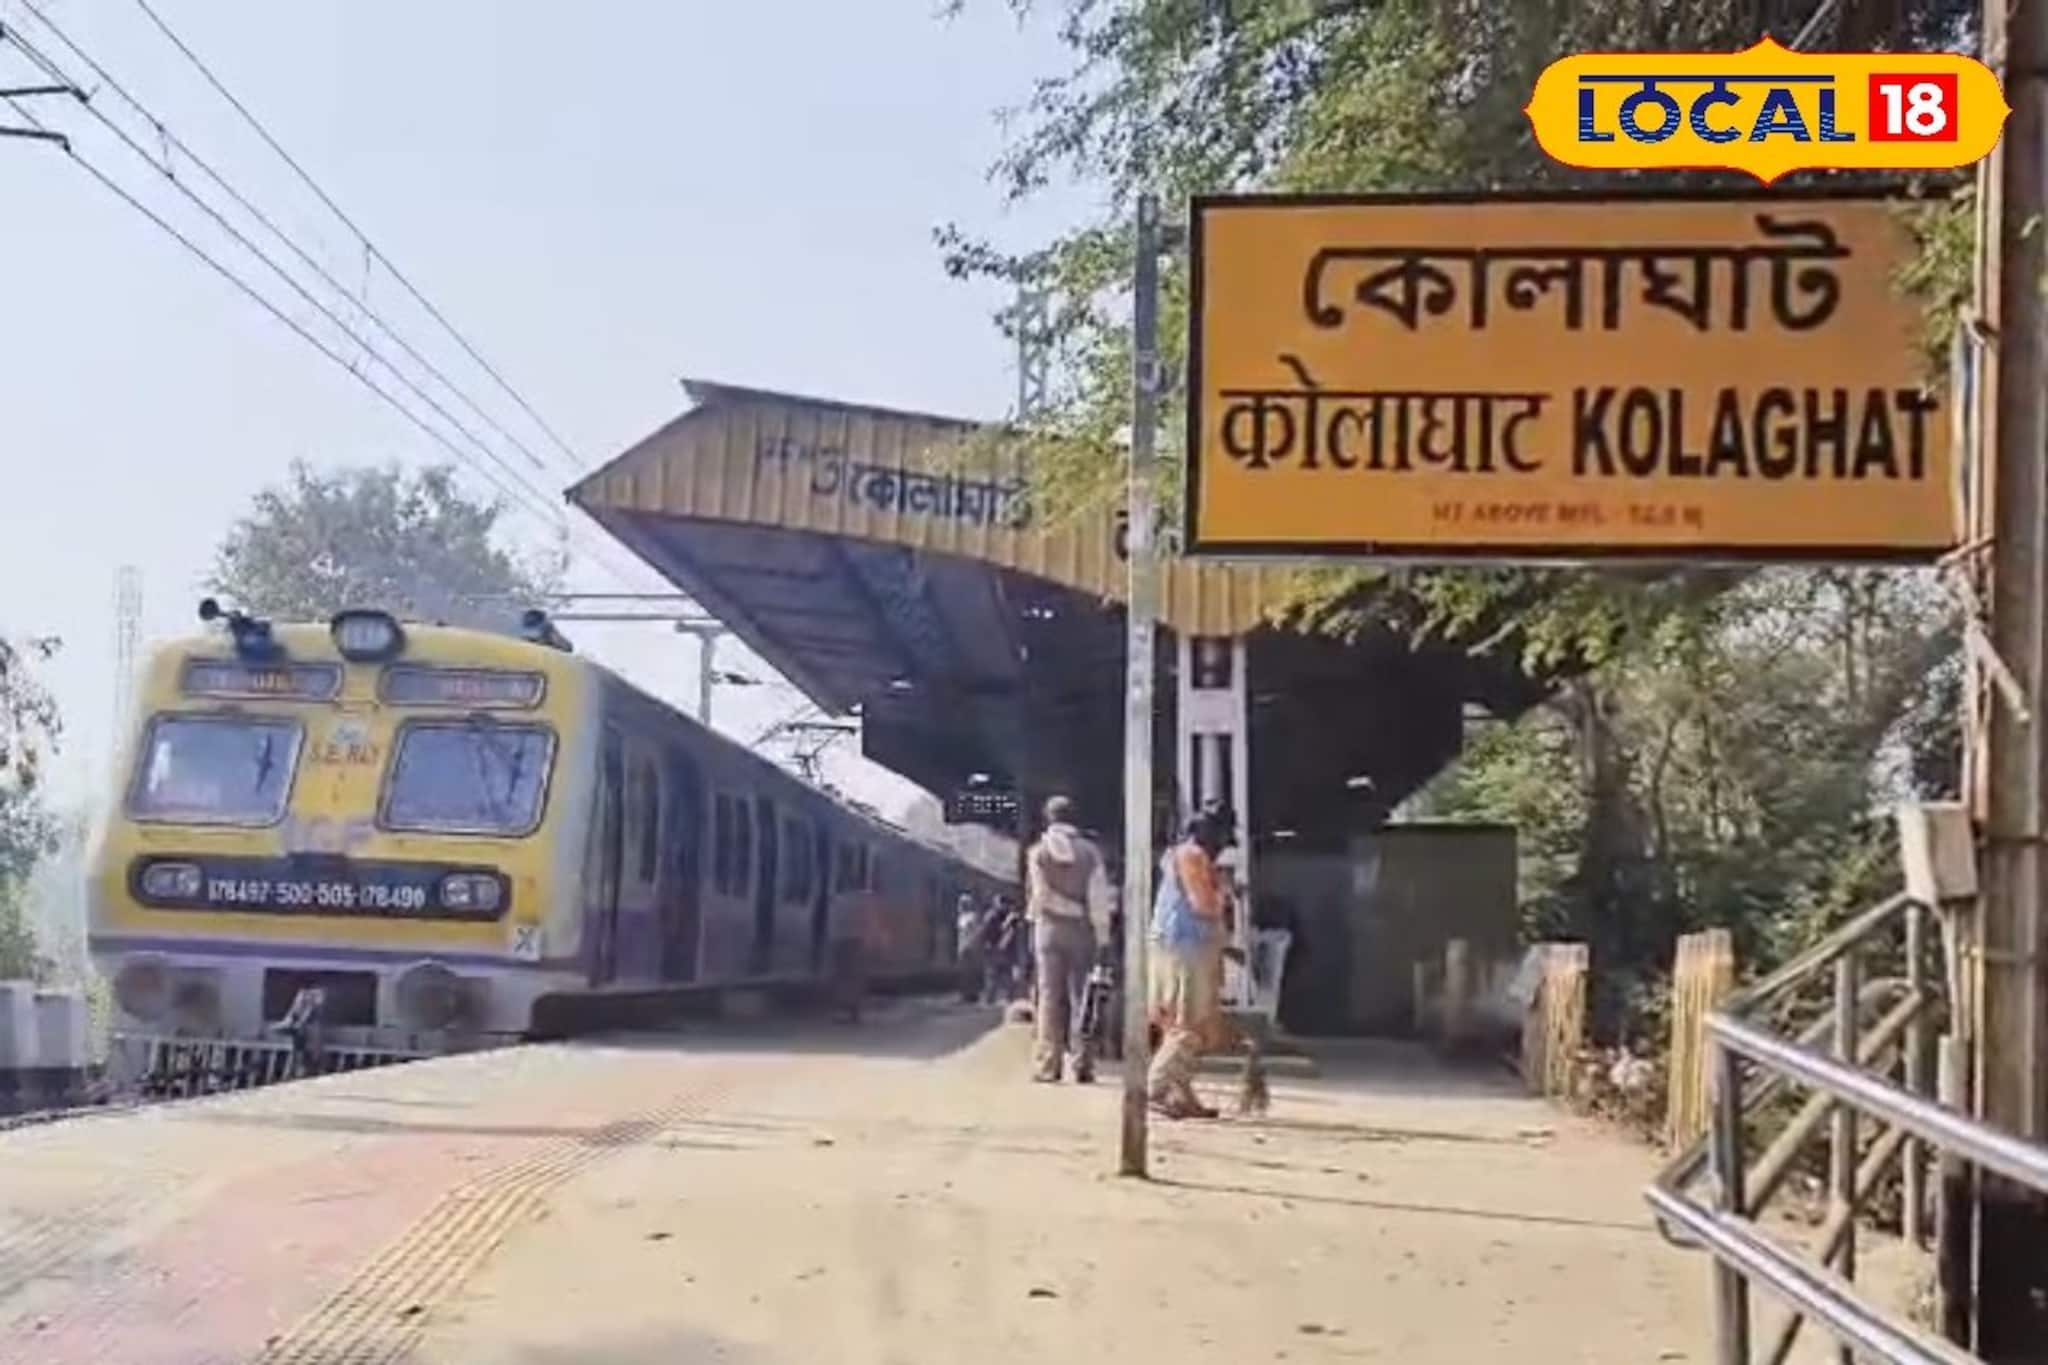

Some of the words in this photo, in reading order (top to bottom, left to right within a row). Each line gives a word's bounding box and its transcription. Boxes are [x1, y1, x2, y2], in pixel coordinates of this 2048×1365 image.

[1304, 213, 1851, 331] কোলাঘাট
[1219, 354, 1552, 471] कोलाघाट
[1573, 386, 1938, 480] KOLAGHAT
